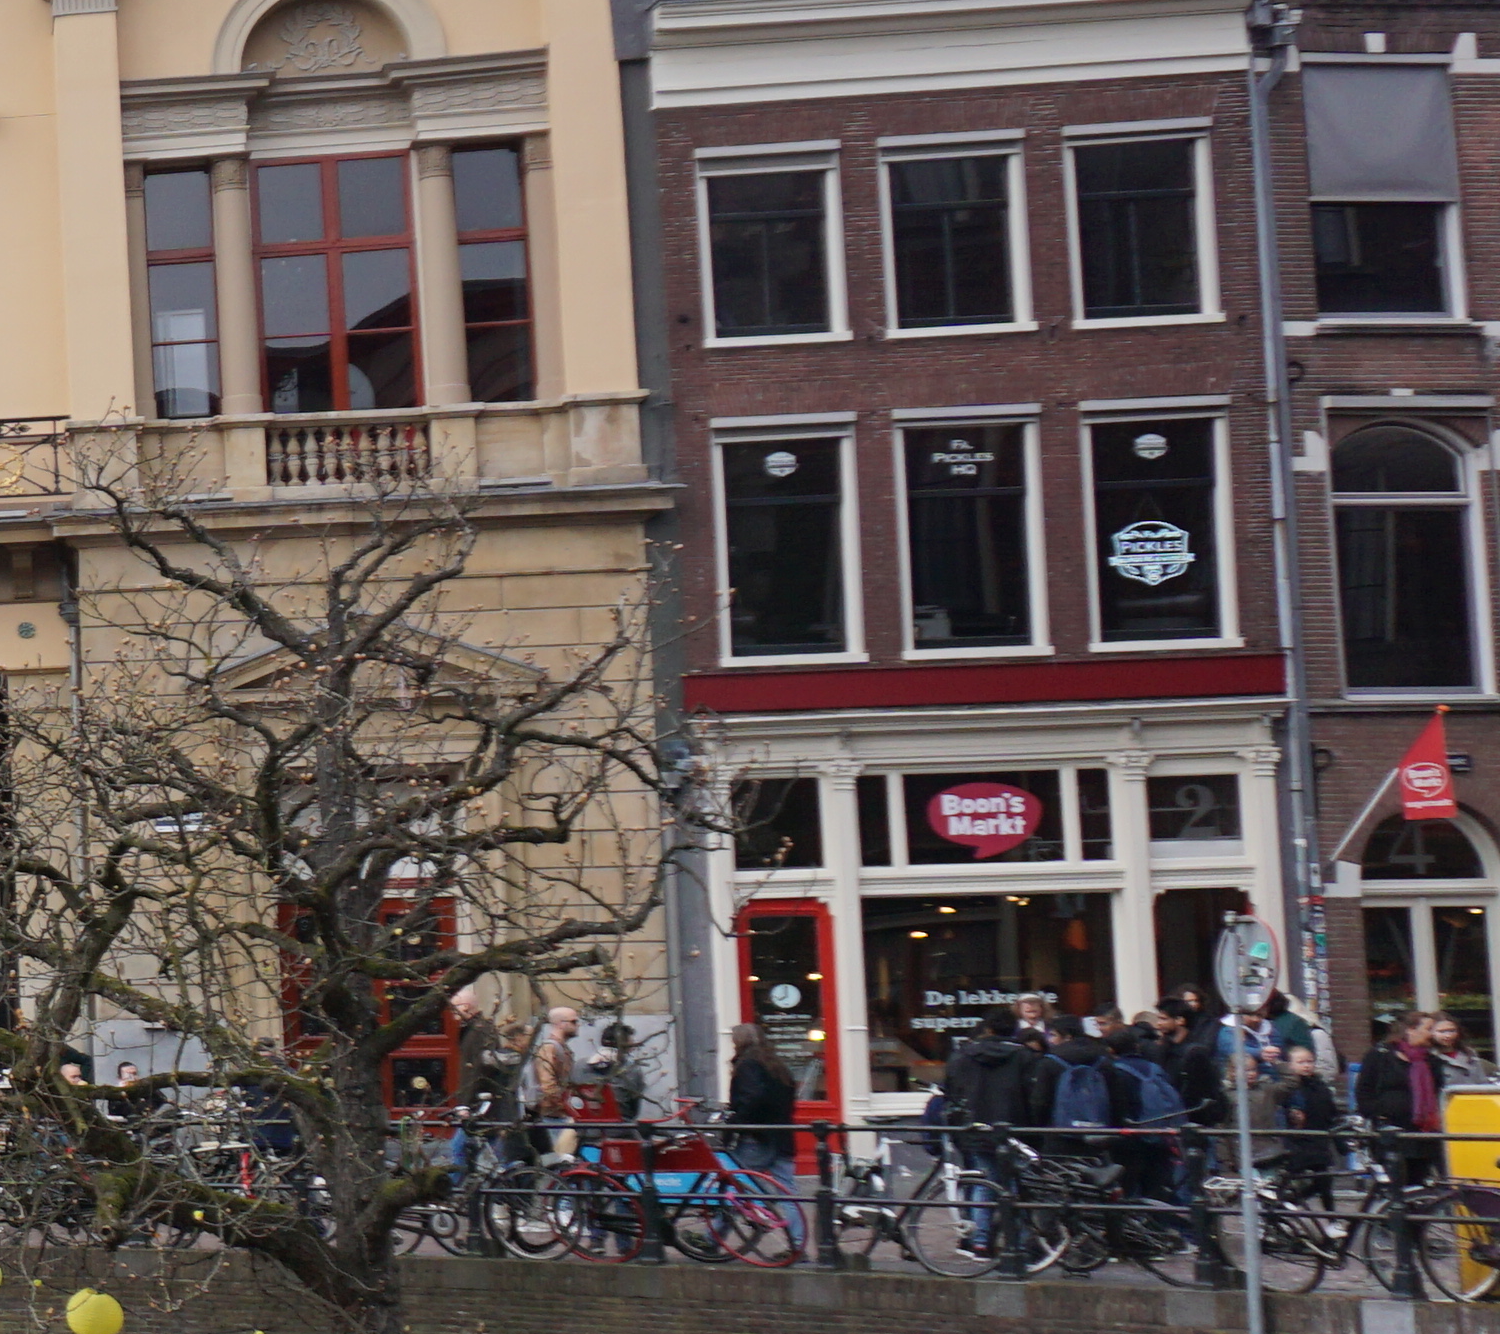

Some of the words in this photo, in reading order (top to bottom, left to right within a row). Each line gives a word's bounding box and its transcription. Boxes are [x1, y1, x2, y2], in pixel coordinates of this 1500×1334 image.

[931, 452, 995, 463] PICKLES
[951, 464, 977, 475] HQ
[1119, 540, 1184, 554] PICKLES
[941, 791, 1026, 816] Boon's
[1176, 784, 1222, 838] 2
[947, 813, 1027, 836] Markt
[924, 989, 956, 1006] De
[957, 989, 1059, 1005] lekkete
